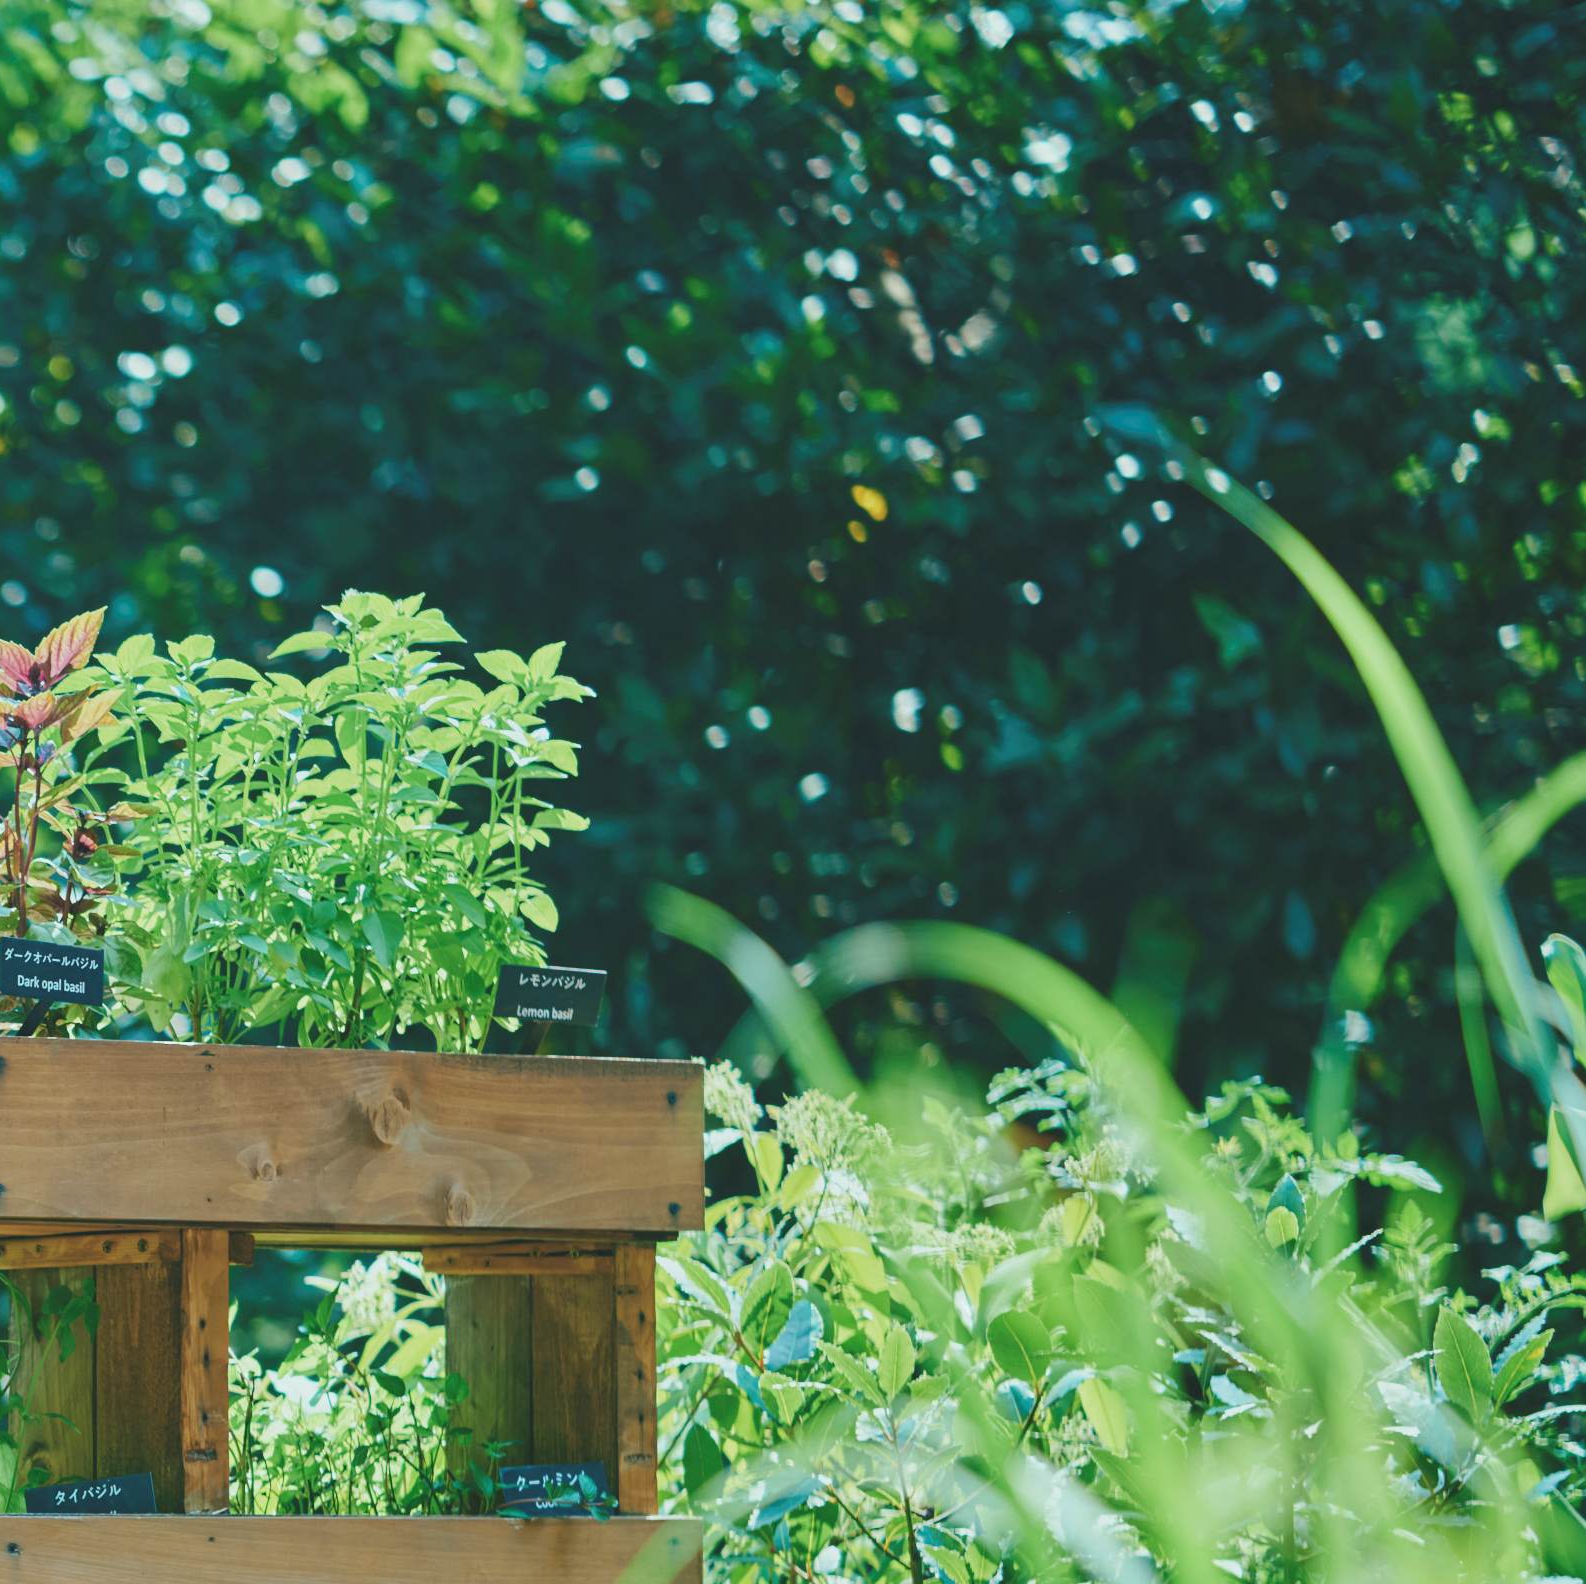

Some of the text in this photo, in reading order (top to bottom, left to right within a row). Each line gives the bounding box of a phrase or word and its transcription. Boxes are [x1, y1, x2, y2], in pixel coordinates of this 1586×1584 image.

[5, 948, 99, 970] ダークオパールバジル
[17, 974, 85, 994] Dark opal basil
[519, 973, 586, 990] レモンバジル
[517, 1004, 574, 1020] Lemon basil
[517, 1470, 585, 1492] クールミン
[55, 1484, 121, 1505] タイバジル
